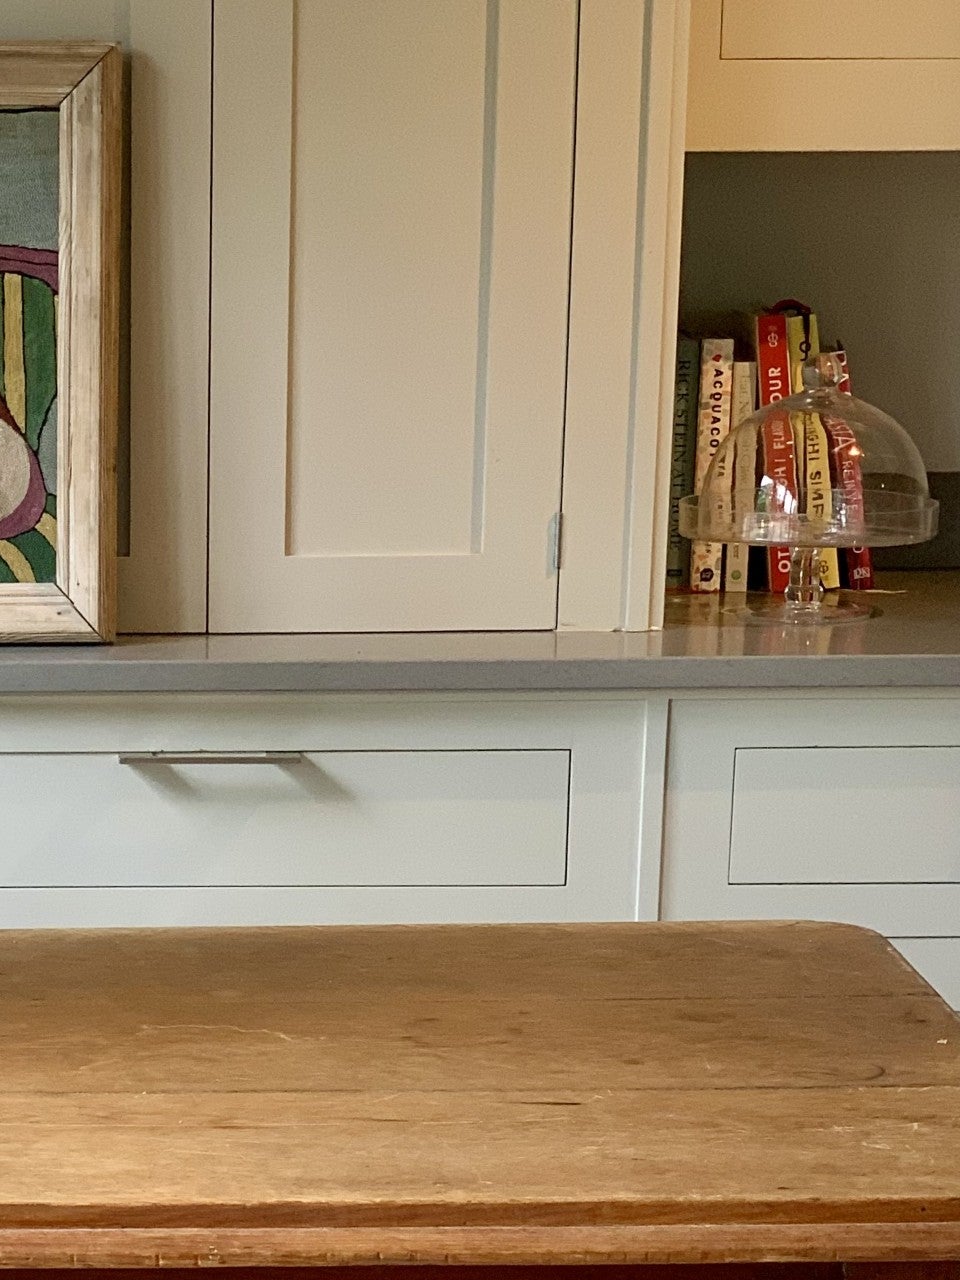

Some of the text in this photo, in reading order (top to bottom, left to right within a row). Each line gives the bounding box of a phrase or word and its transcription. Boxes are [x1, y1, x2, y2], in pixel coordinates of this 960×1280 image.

[669, 360, 691, 550] RICK STEIN AT HOME
